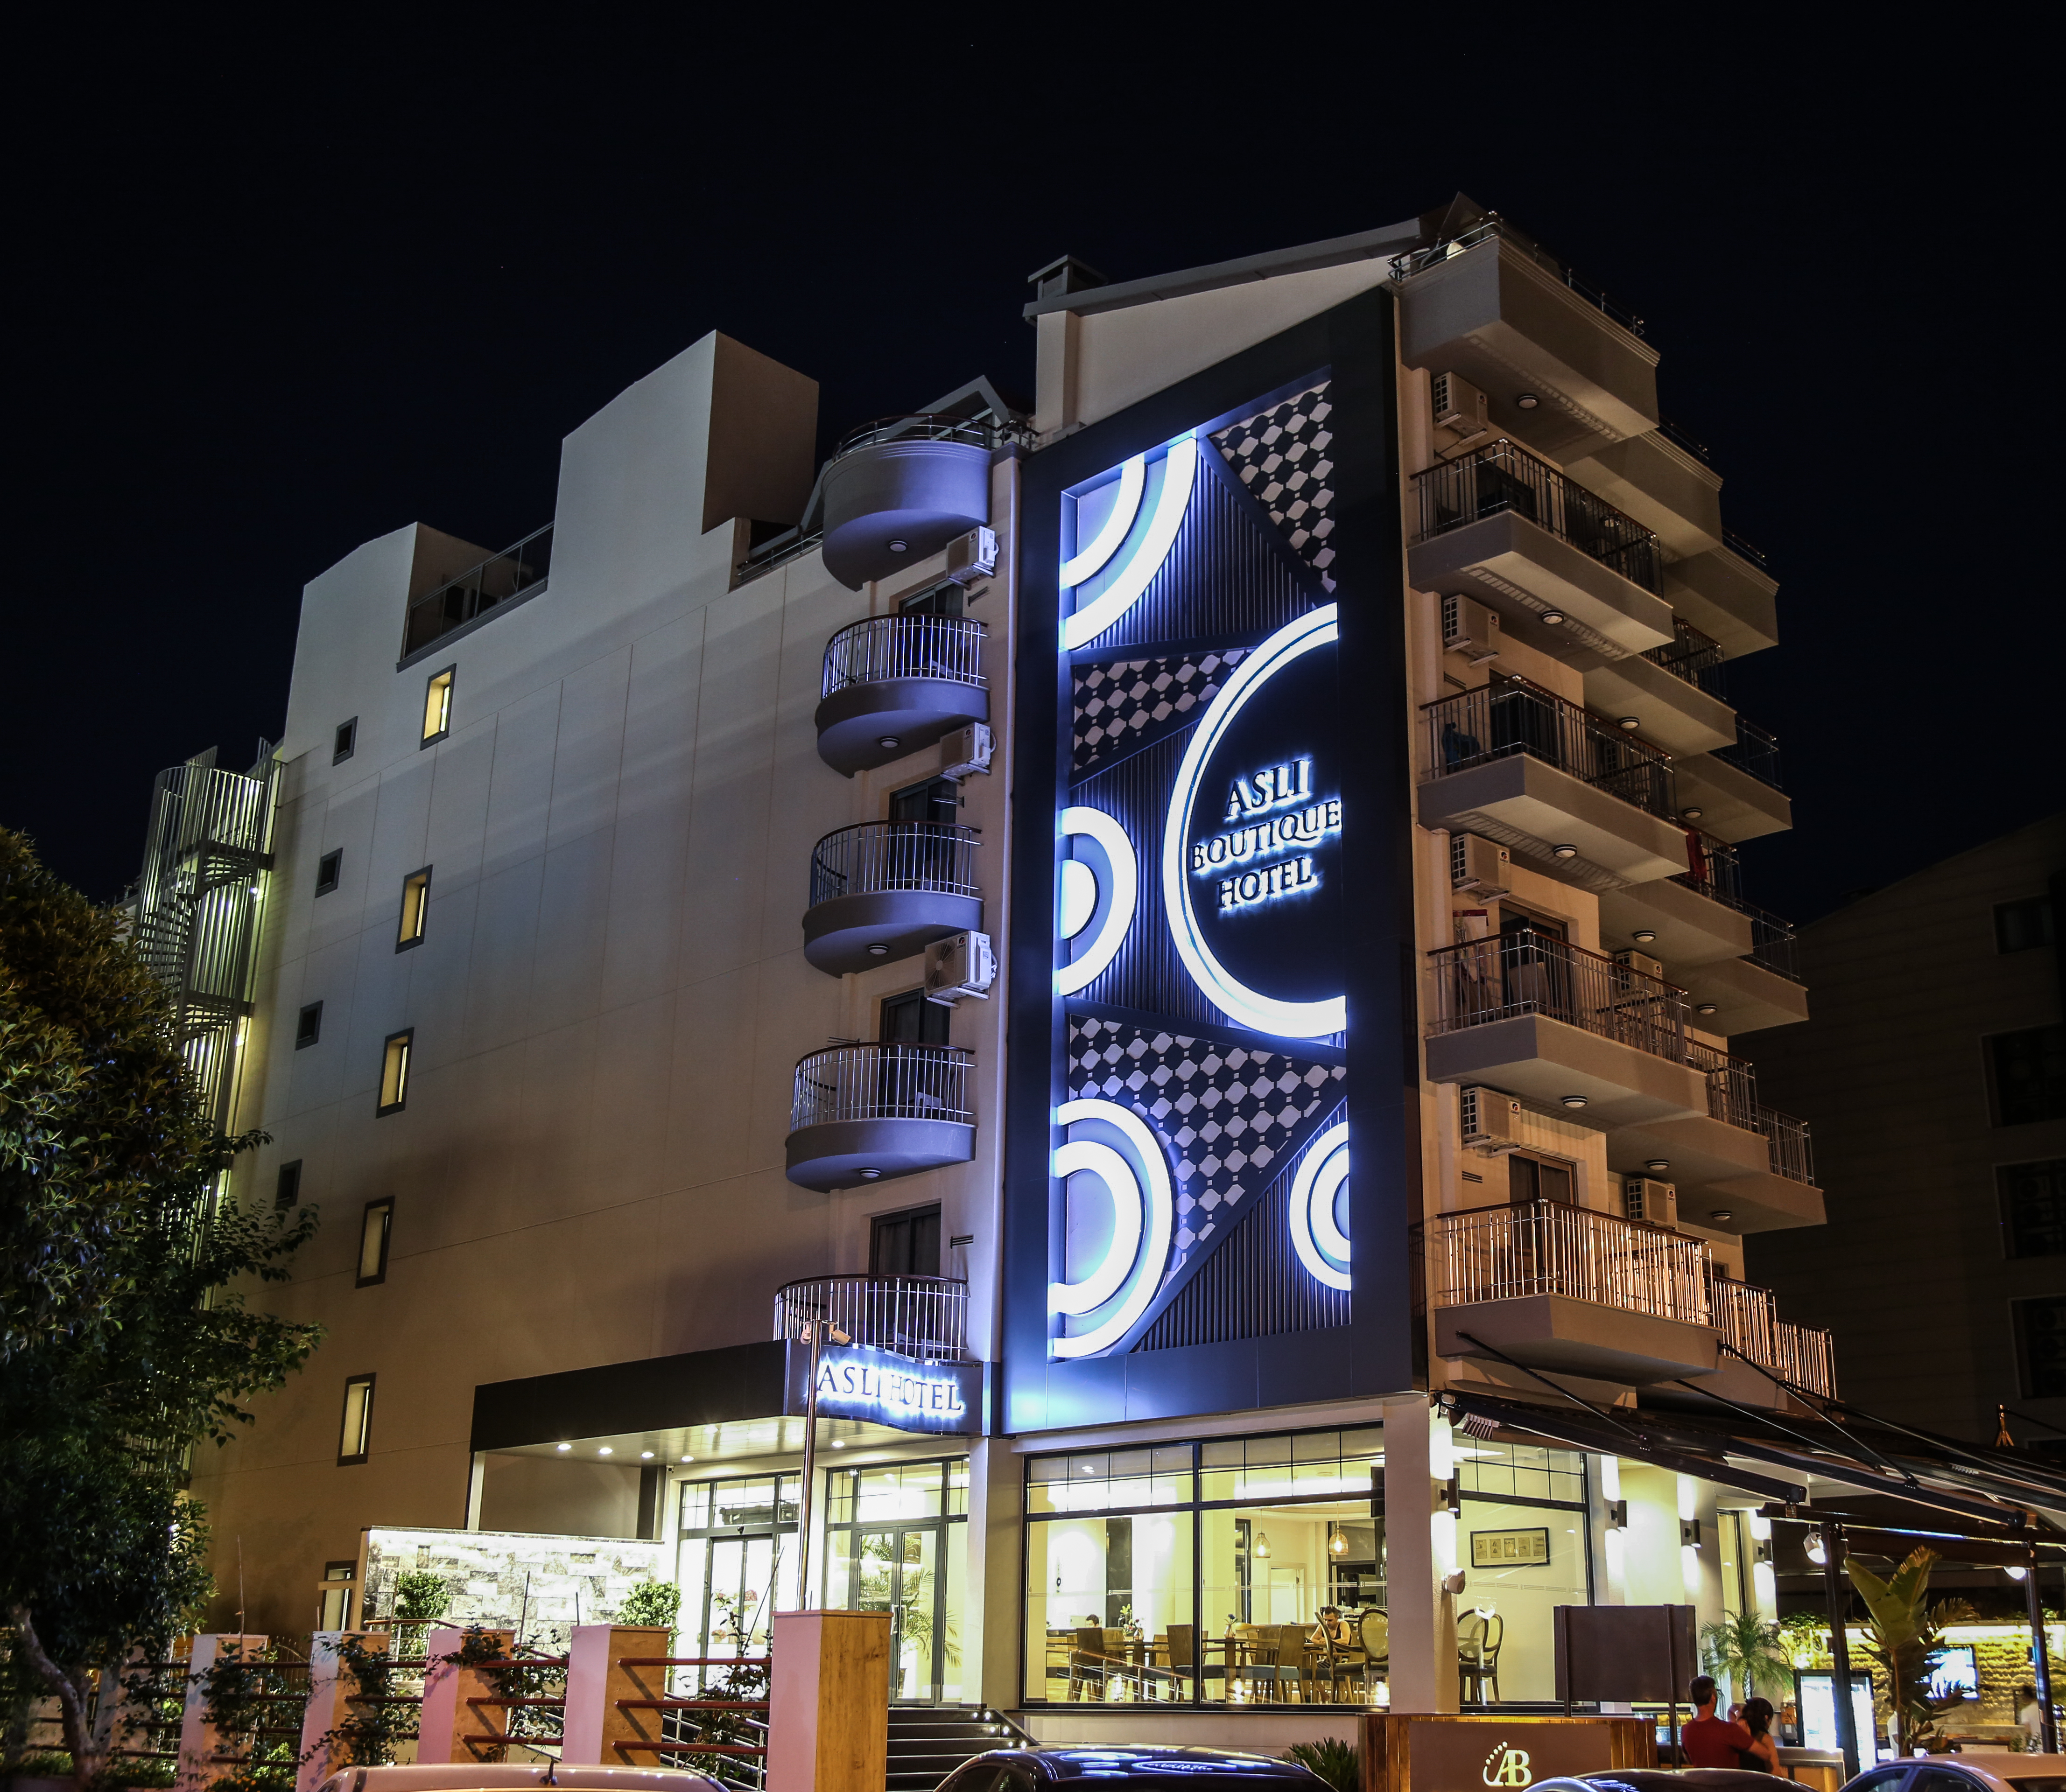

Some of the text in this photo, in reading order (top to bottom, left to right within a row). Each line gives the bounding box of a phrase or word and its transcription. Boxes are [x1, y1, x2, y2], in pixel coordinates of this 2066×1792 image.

[1223, 759, 1311, 819] ASLI
[1190, 799, 1342, 872] BOUTIQUE
[1216, 857, 1314, 909] HOTEL
[818, 1364, 962, 1411] ASLI HOTEL
[1482, 1749, 1532, 1787] AB
